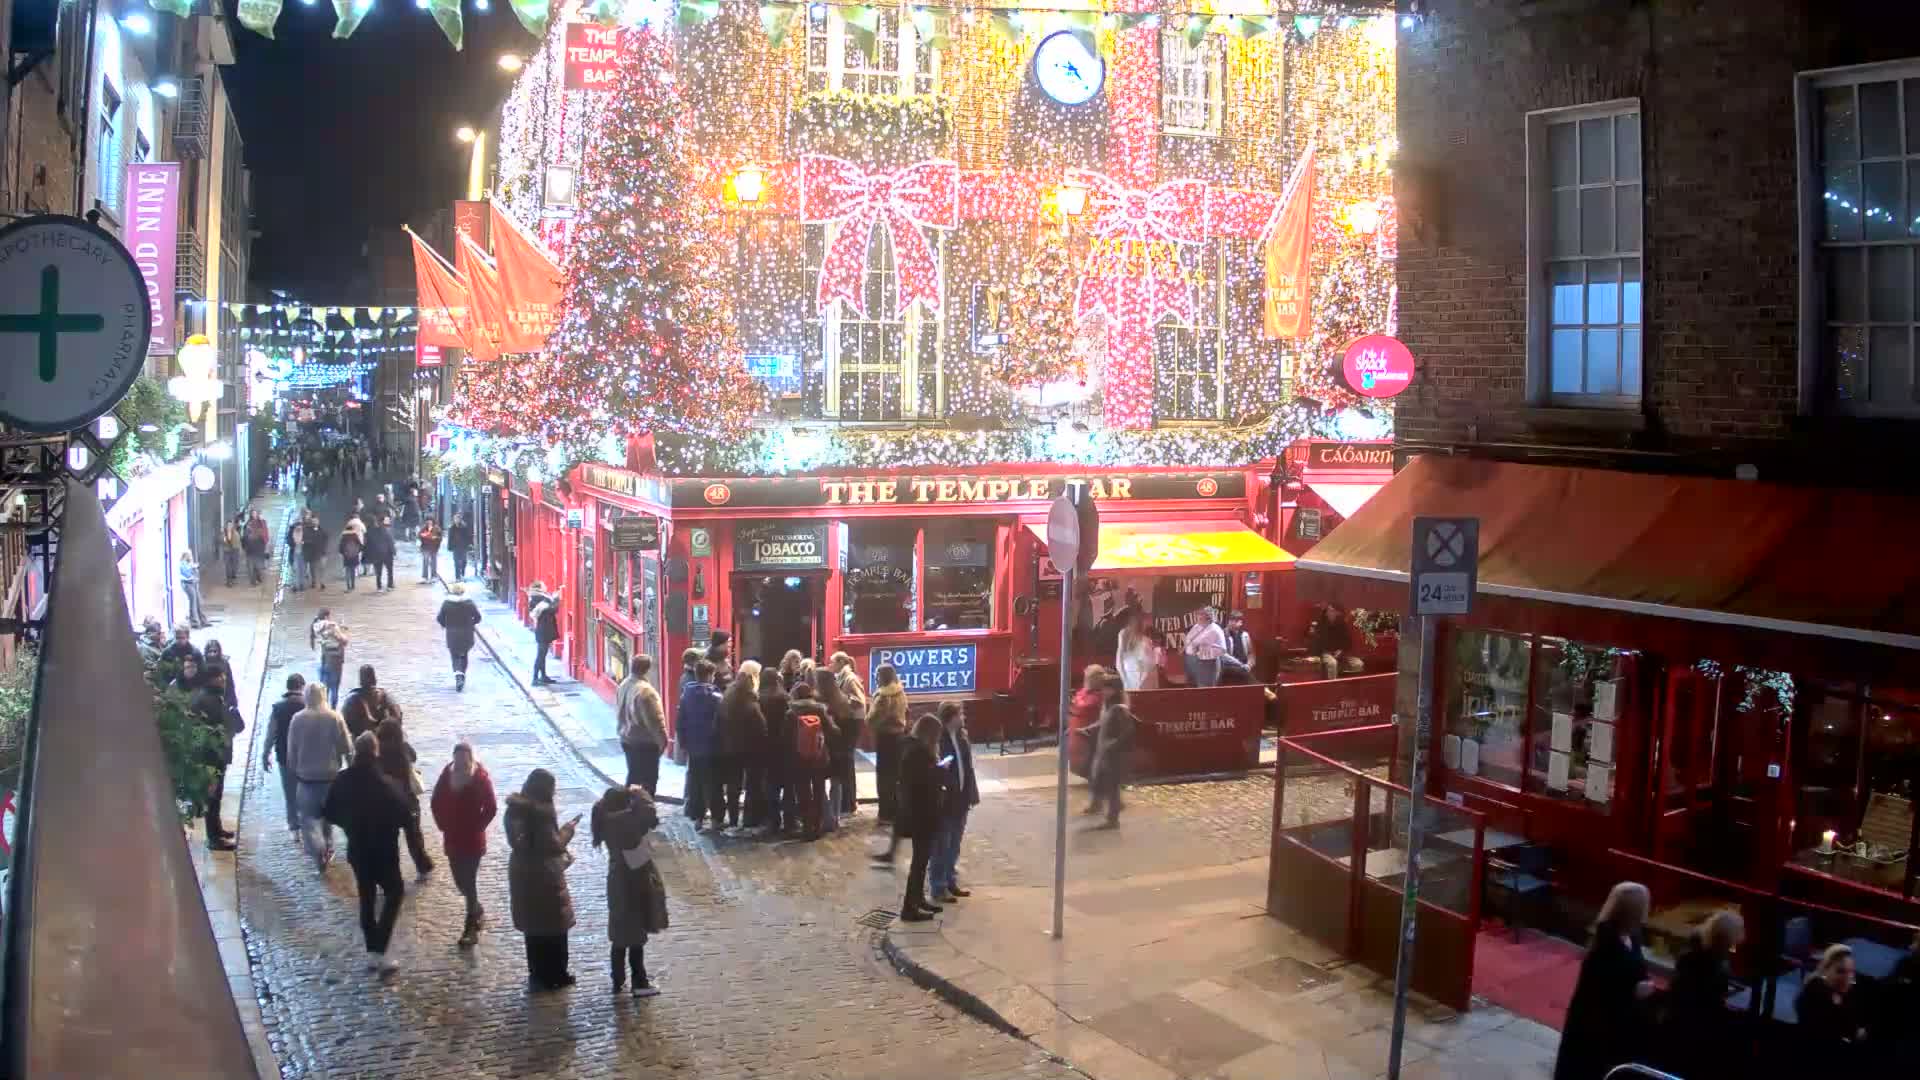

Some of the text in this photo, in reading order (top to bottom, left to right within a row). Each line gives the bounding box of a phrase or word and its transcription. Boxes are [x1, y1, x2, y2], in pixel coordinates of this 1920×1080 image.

[584, 29, 617, 45] THE
[137, 170, 169, 233] NINE
[823, 478, 1132, 503] THE TEMPLE AR
[752, 539, 816, 561] TOBACCO
[1175, 578, 1225, 593] EMPEROR
[1420, 583, 1442, 602] 24
[1211, 593, 1224, 606] OF
[880, 647, 969, 666] POWER'S
[900, 671, 973, 689] HISKEY
[1311, 704, 1381, 722] TEMPLE BAR
[1155, 718, 1236, 732] TEMPLE BAR
